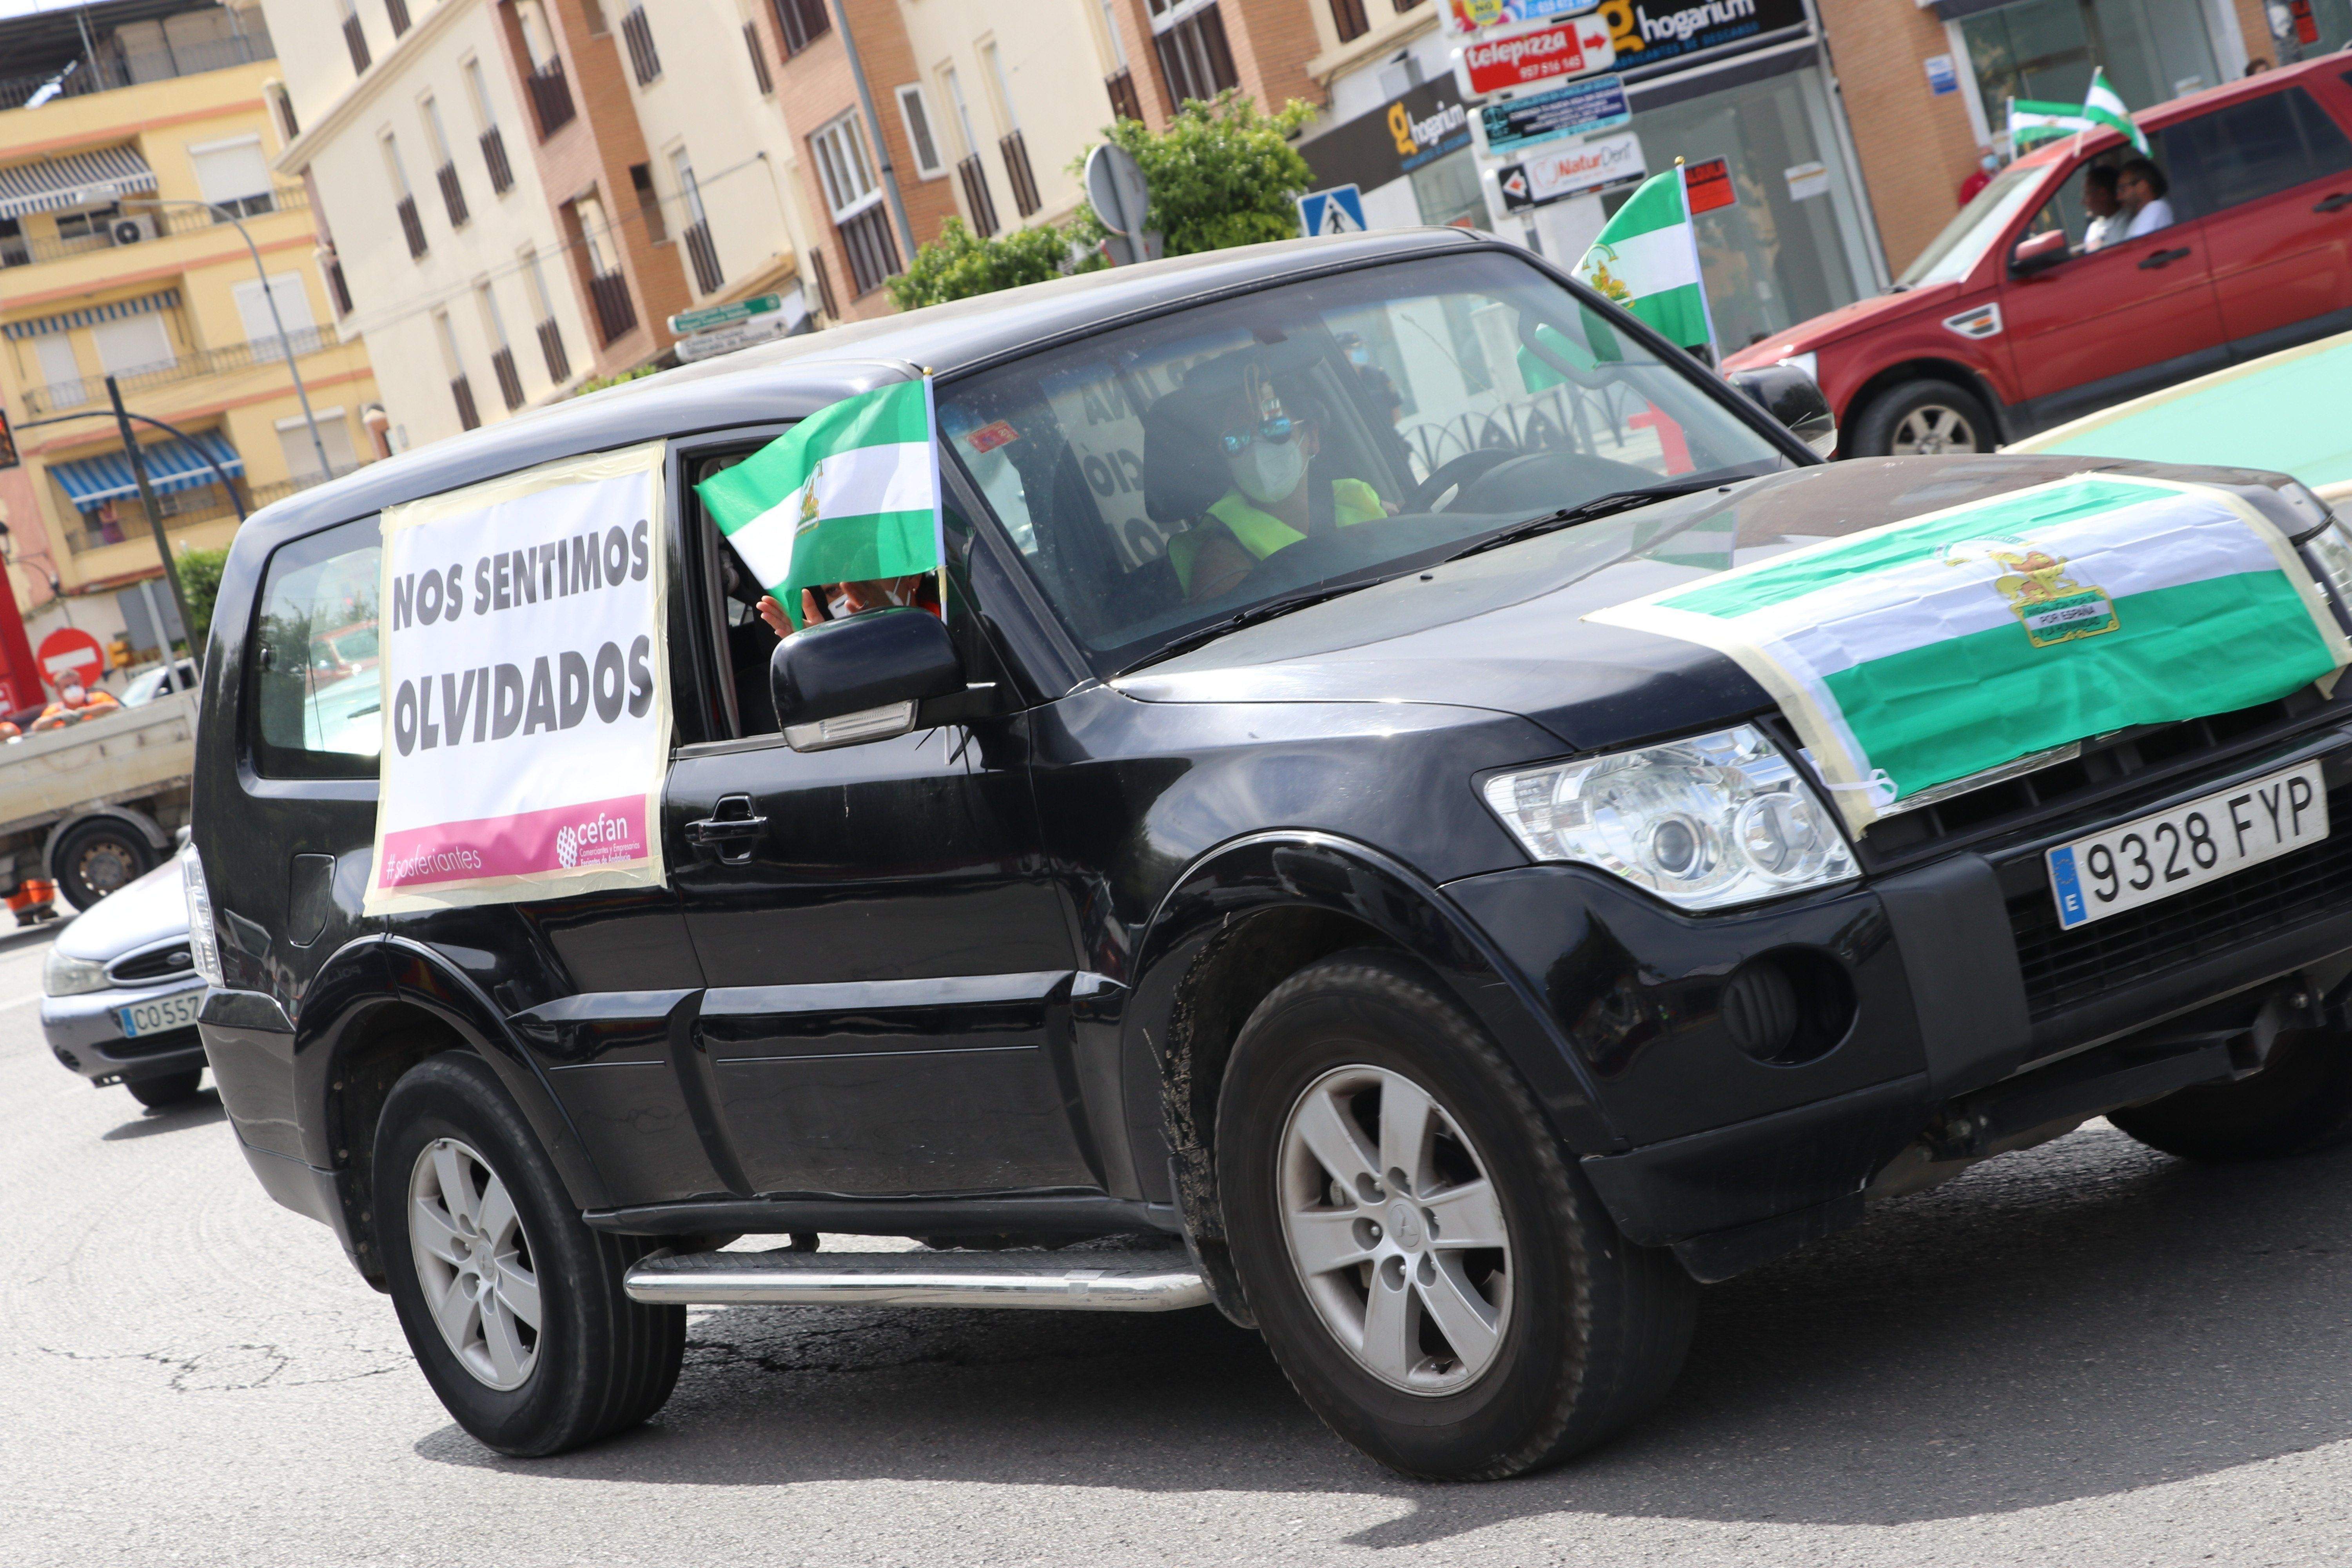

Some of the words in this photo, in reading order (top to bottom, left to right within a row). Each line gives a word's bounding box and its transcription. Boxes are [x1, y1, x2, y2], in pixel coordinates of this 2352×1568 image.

[1636, 0, 1756, 43] hogarium
[1467, 30, 1567, 69] telepizza
[393, 563, 463, 632] NOS
[474, 519, 648, 615] SENTIMOS
[394, 635, 653, 757] OLVIDADOS
[578, 812, 628, 845] cefan
[2087, 811, 2218, 902] 9328
[2229, 776, 2312, 857] FYP
[386, 844, 482, 880] #sosferiantes
[580, 846, 608, 857] Comerciantes
[609, 847, 613, 855] y
[2065, 895, 2079, 911] E
